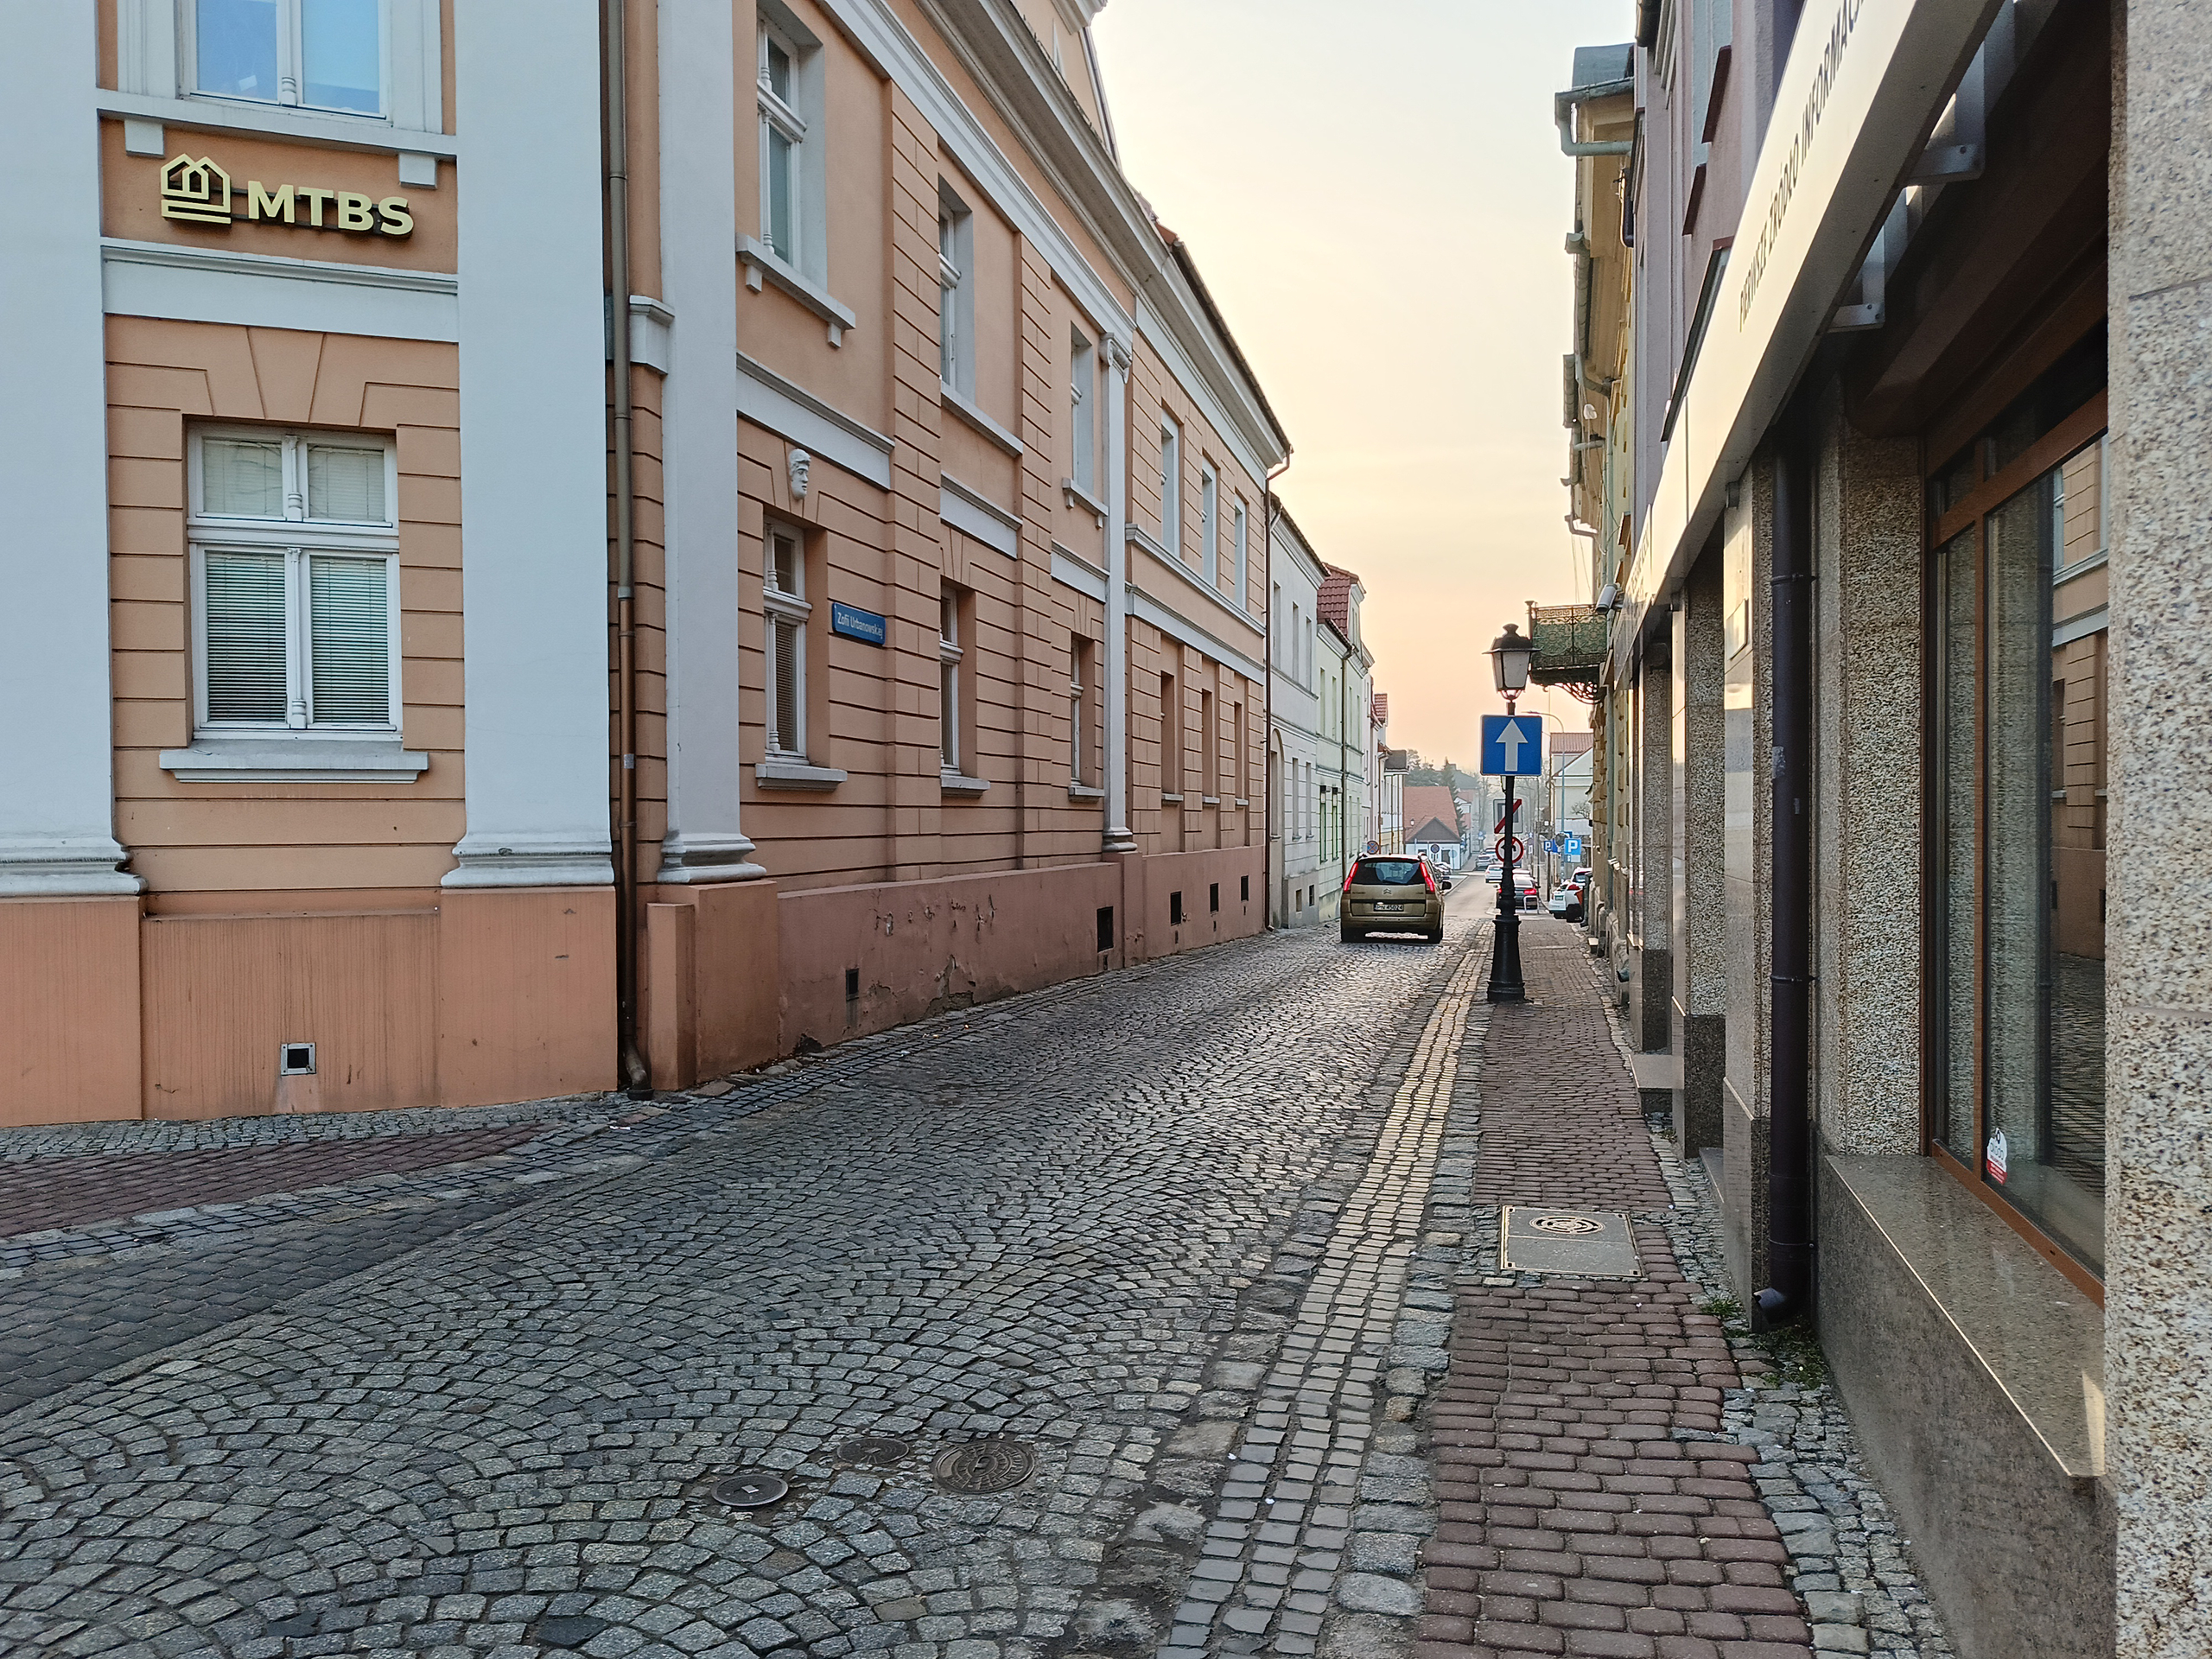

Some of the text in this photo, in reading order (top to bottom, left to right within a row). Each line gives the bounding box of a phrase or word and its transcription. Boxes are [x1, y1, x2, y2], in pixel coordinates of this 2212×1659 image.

[247, 180, 415, 236] MTBS
[1738, 219, 1768, 334] PIERWSZE
[1768, 132, 1800, 257] ŹRÓDŁO
[837, 612, 883, 639] Zofii Urbanowskiej
[1567, 839, 1579, 853] P
